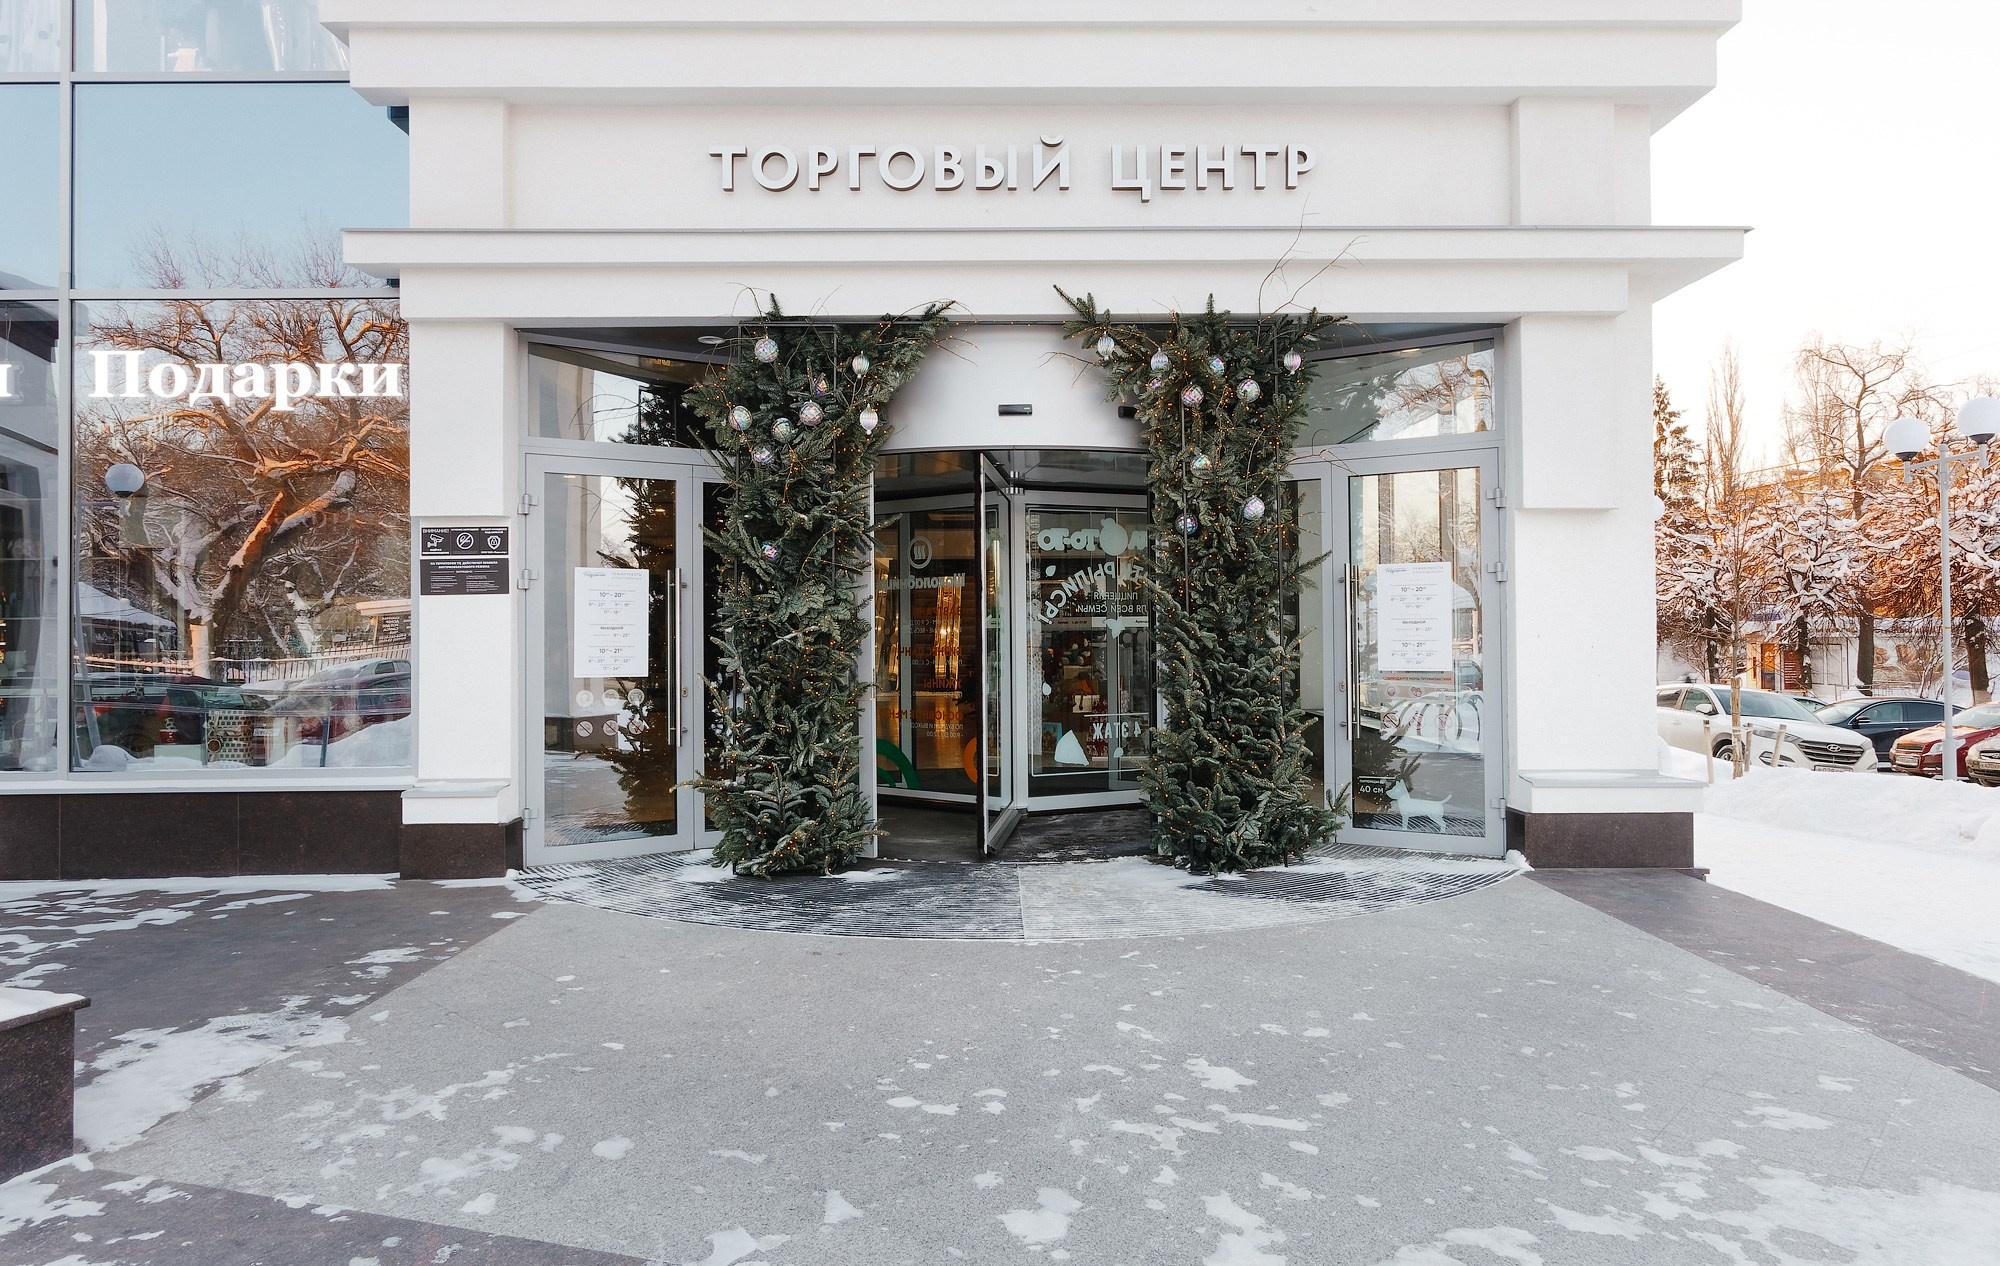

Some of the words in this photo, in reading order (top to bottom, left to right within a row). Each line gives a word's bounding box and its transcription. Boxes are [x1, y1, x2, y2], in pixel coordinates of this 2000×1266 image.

[708, 133, 1071, 192] ТОРГОВЫЙ
[1111, 144, 1317, 203] ЦЕНТР
[87, 349, 403, 411] Подарки
[1360, 785, 1371, 793] 40
